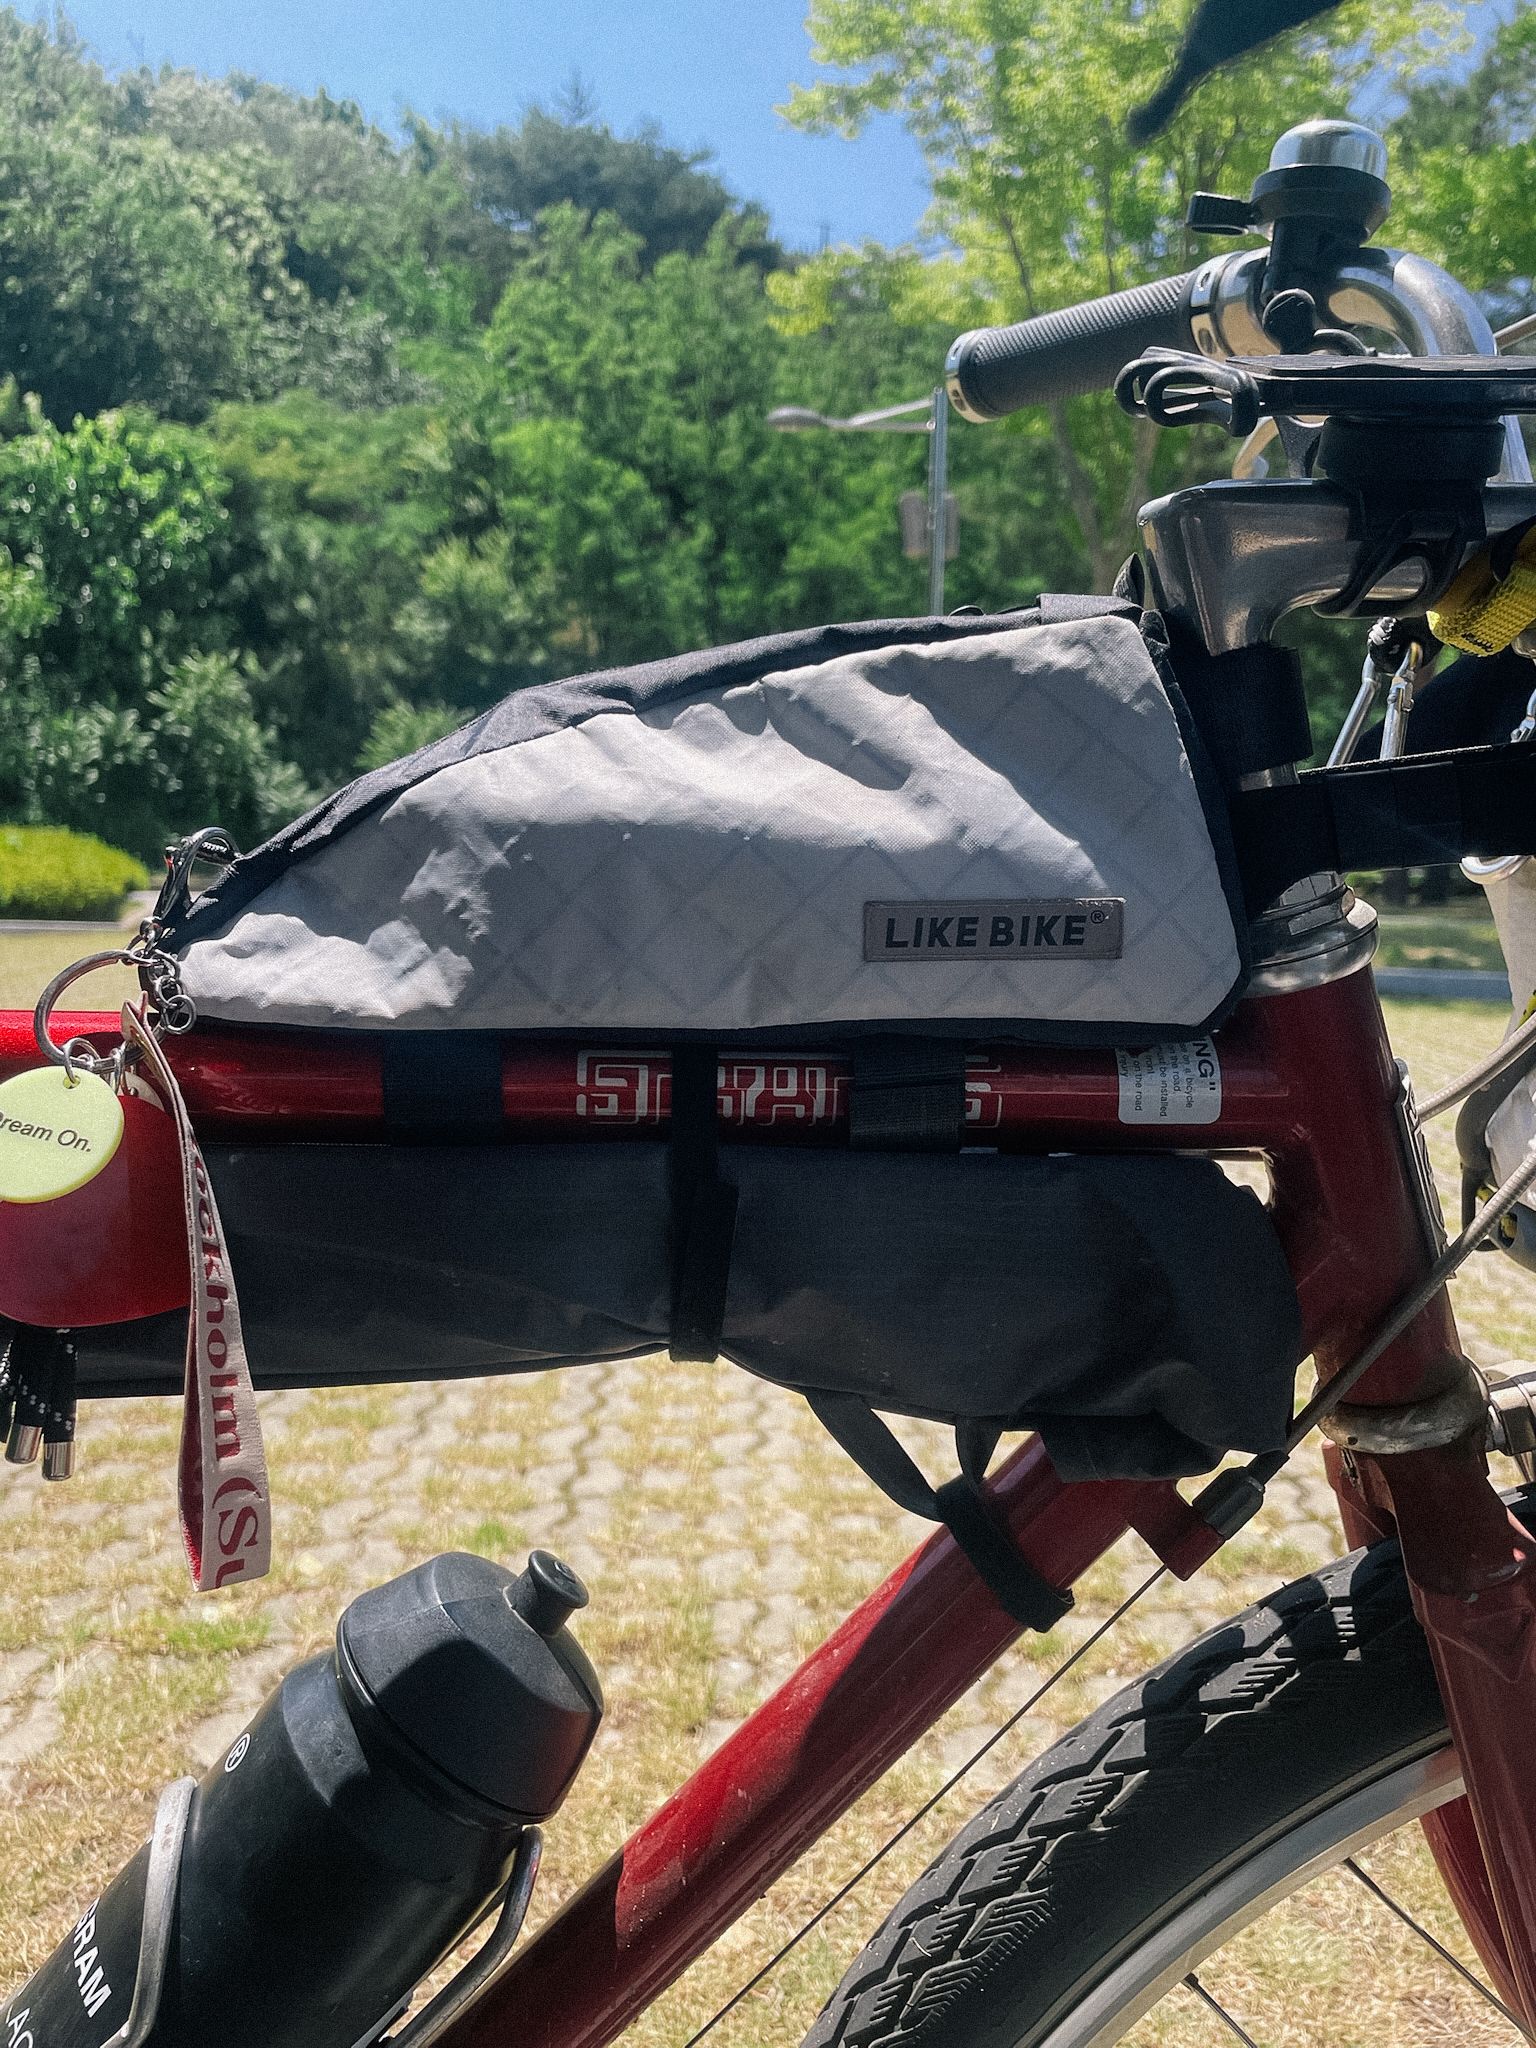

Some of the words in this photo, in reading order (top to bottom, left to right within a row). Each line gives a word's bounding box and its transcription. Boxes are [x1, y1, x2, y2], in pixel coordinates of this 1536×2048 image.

[885, 917, 979, 948] LIKE
[1133, 1060, 1142, 1072] on
[1159, 1066, 1168, 1078] be
[1134, 1074, 1143, 1088] the
[1185, 1077, 1195, 1108] bicycle
[1135, 1090, 1144, 1112] road
[1159, 1080, 1169, 1117] installed
[57, 1129, 92, 1152] On.
[190, 1132, 243, 1462] ockholm
